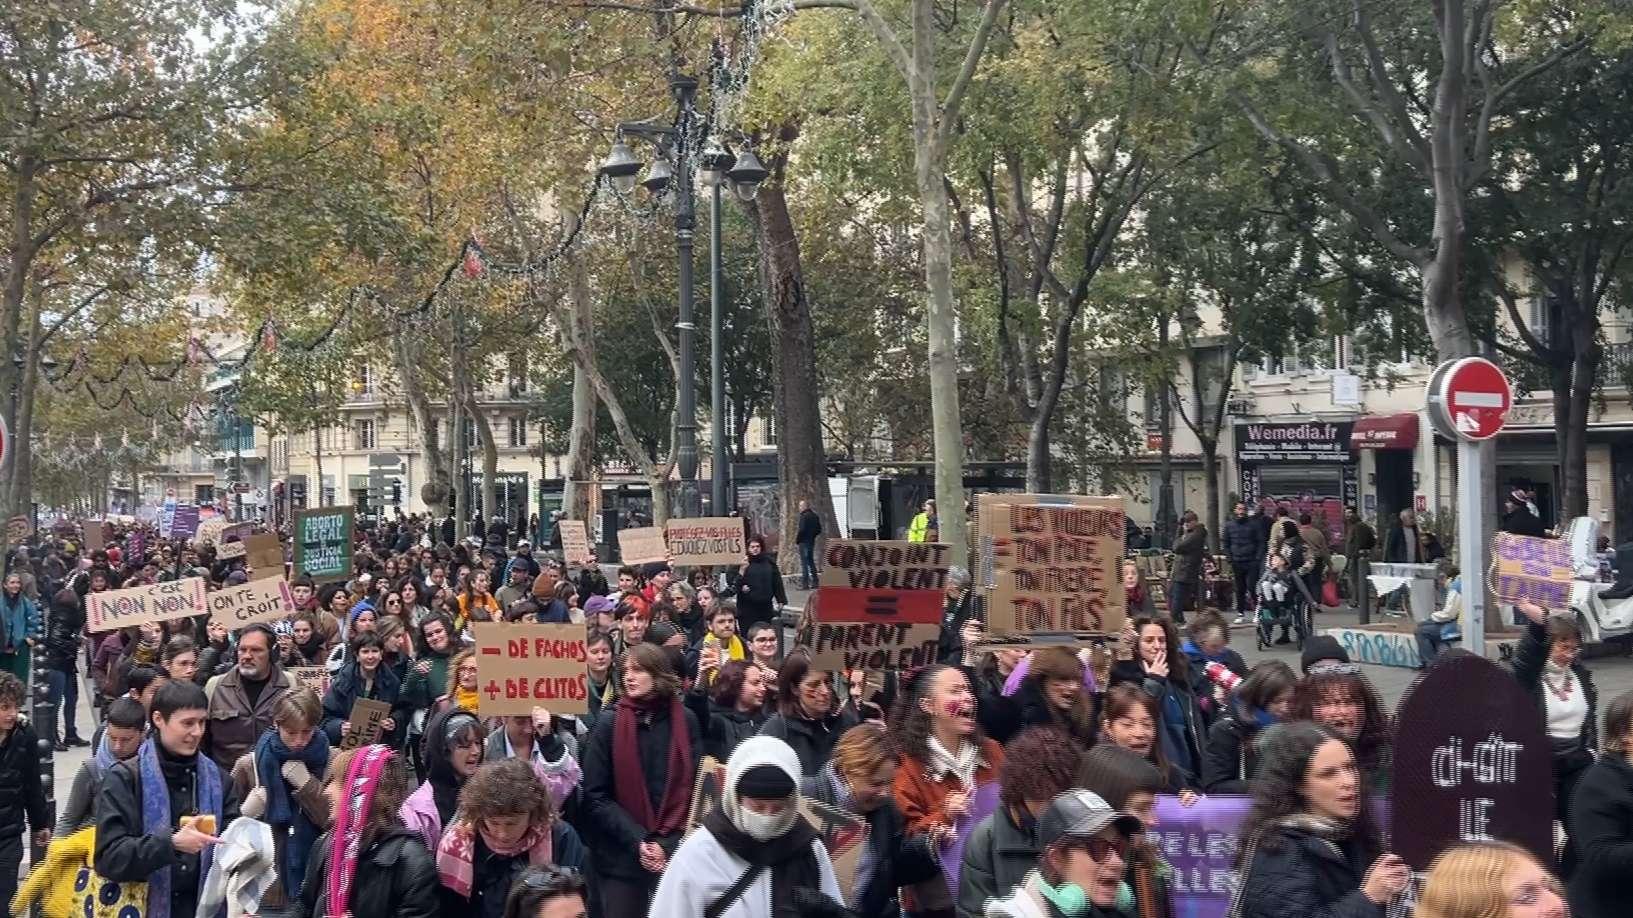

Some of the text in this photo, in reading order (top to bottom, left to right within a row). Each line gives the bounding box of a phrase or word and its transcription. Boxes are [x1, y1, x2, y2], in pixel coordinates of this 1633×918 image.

[1248, 423, 1338, 440] Wemedia.fr
[305, 514, 343, 530] ABORTO
[1009, 506, 1126, 540] LES VIOLEURS
[305, 528, 343, 544] LEGAL
[826, 542, 952, 569] CONJOINT
[1011, 537, 1050, 563] TON
[303, 556, 343, 571] SOCIAL
[148, 583, 186, 596] c'est
[847, 567, 950, 590] VIOLENT
[1012, 566, 1050, 592] TON
[101, 594, 146, 622] NON
[213, 588, 256, 611] ON TE
[1009, 596, 1055, 632] TON
[507, 638, 528, 660] DE
[534, 637, 588, 664] FACHOS
[816, 621, 913, 655] PARENT
[844, 640, 942, 671] VIOLENT
[505, 677, 528, 700] DE
[533, 672, 588, 701] CLITOS
[1458, 797, 1496, 843] LE
[1145, 831, 1185, 856] RE
[1166, 865, 1243, 892] LLES
